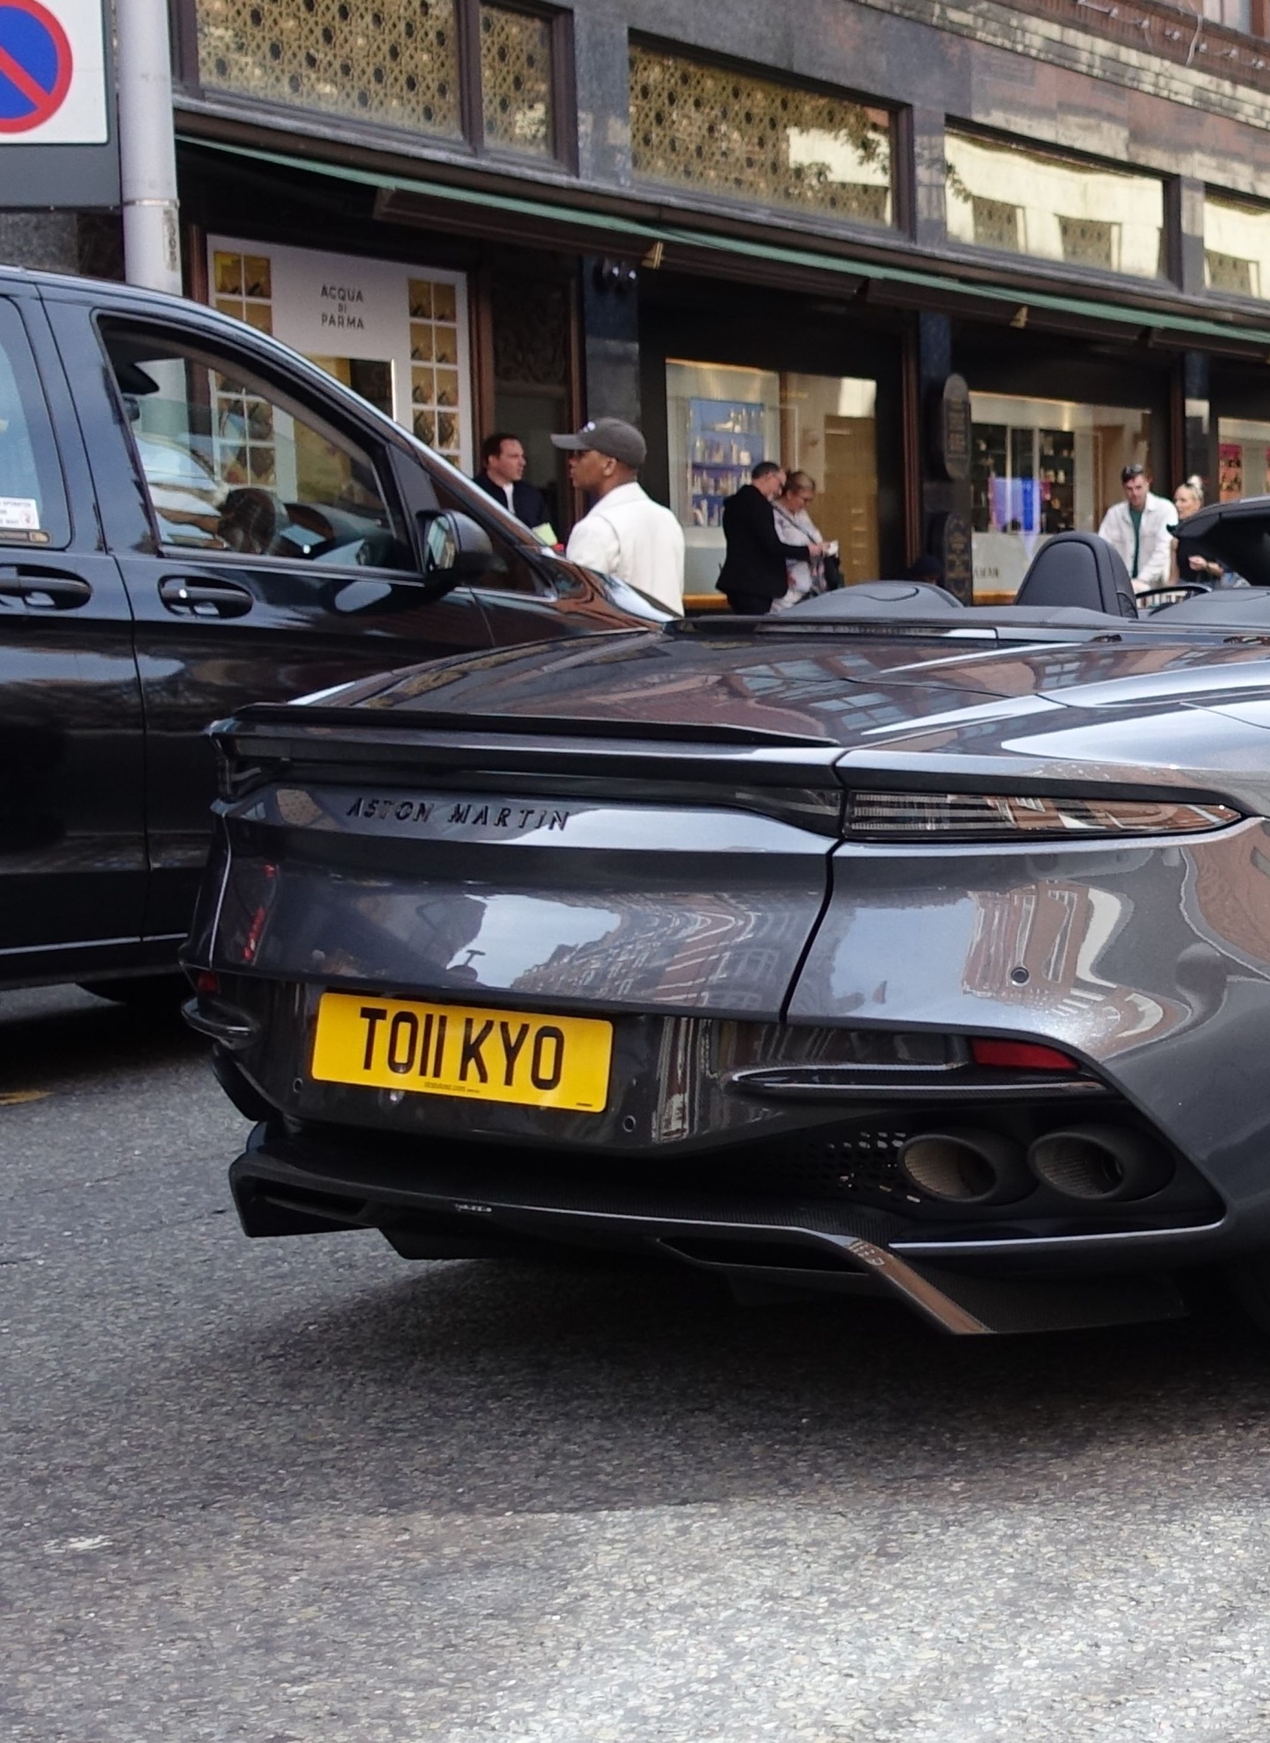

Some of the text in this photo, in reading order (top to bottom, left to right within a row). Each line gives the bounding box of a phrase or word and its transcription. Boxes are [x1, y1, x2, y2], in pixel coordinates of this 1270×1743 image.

[321, 285, 363, 302] ACQUA
[338, 303, 347, 313] DI
[321, 313, 364, 329] PARMA
[346, 798, 569, 831] ASTON MARTIN
[459, 1017, 565, 1090] KYO
